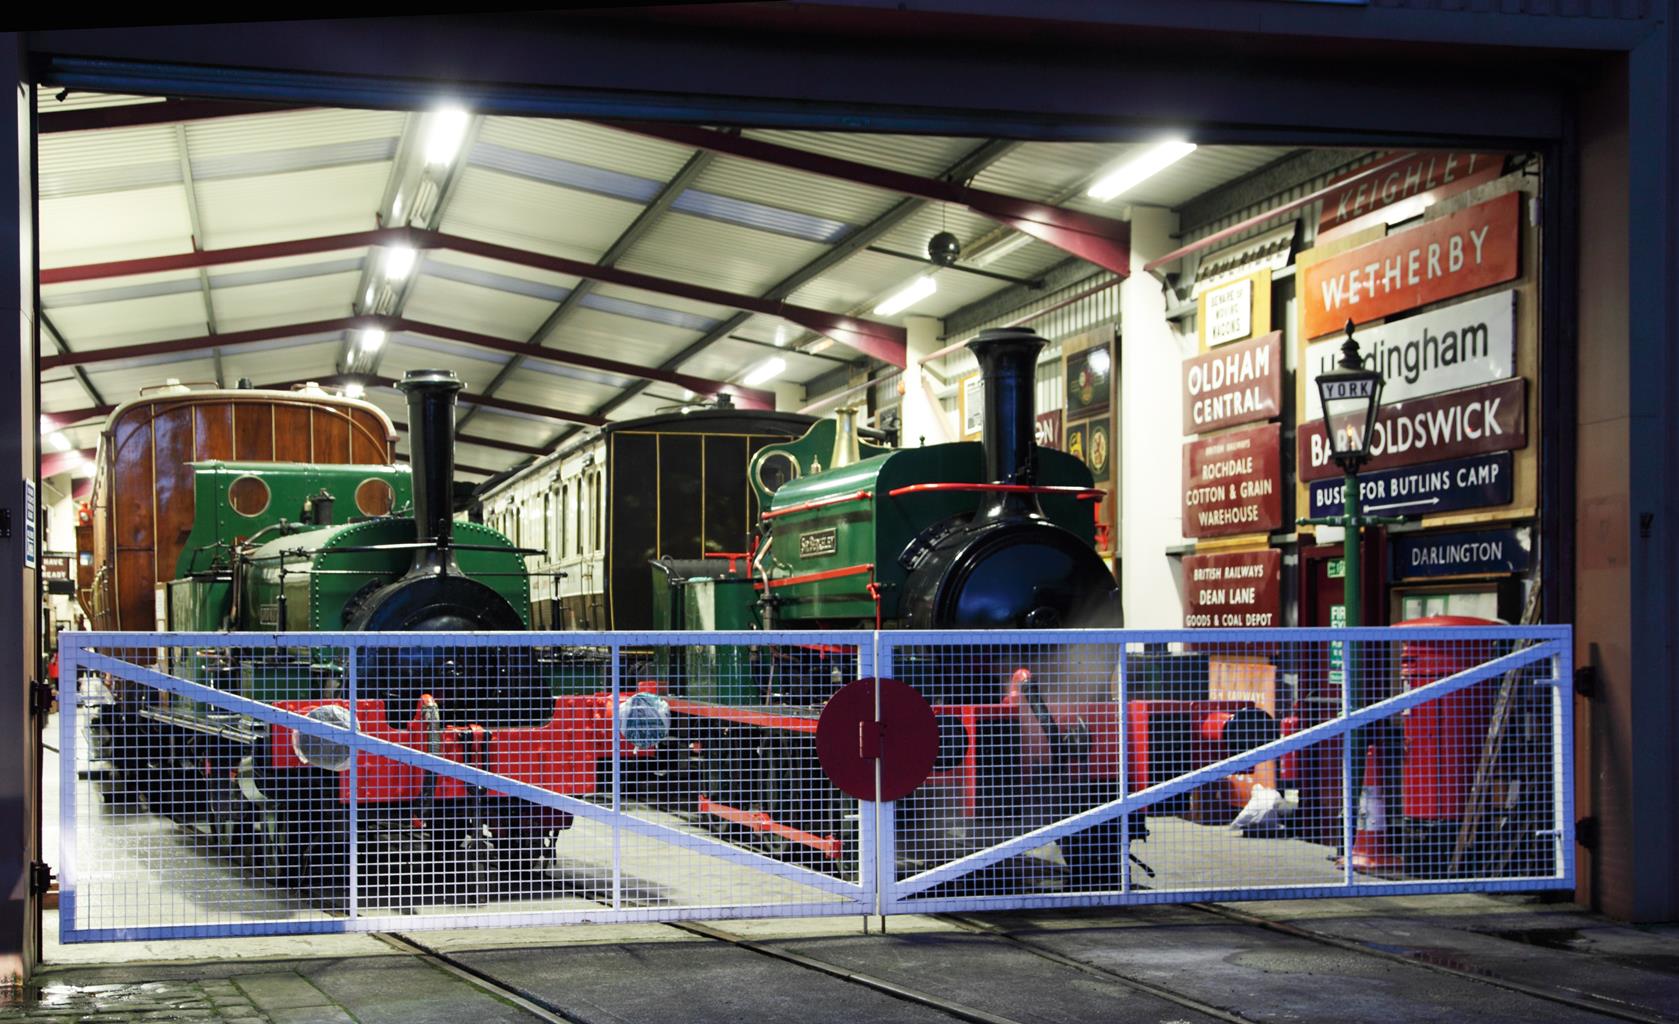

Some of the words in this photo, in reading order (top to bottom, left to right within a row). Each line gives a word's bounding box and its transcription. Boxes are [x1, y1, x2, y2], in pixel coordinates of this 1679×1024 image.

[1336, 153, 1477, 221] KEIGHLEY
[1321, 225, 1489, 313] WETHERBY
[1188, 344, 1269, 396] OLDHAM
[1326, 381, 1368, 398] YORK
[1193, 386, 1264, 424] CENTRAL
[1202, 457, 1253, 480] ROCHDALE
[1186, 486, 1225, 506] COTTON
[1229, 484, 1237, 501] &
[1240, 478, 1273, 499] GRAIN
[1359, 480, 1386, 501] FOR
[1390, 471, 1450, 497] BUTLINS
[1457, 463, 1500, 488] CAMP
[1198, 504, 1259, 527] WAREHOUSE
[1412, 541, 1503, 566] DARLINGTON
[1194, 567, 1222, 581] BRITISH
[1224, 564, 1264, 579] RAILWAYS
[1199, 588, 1225, 606] DEAN
[1229, 587, 1256, 605] LANE
[1186, 614, 1211, 627] GOODS
[1213, 614, 1219, 626] &
[1222, 614, 1243, 626] COAL
[1245, 613, 1273, 626] DEPOT
